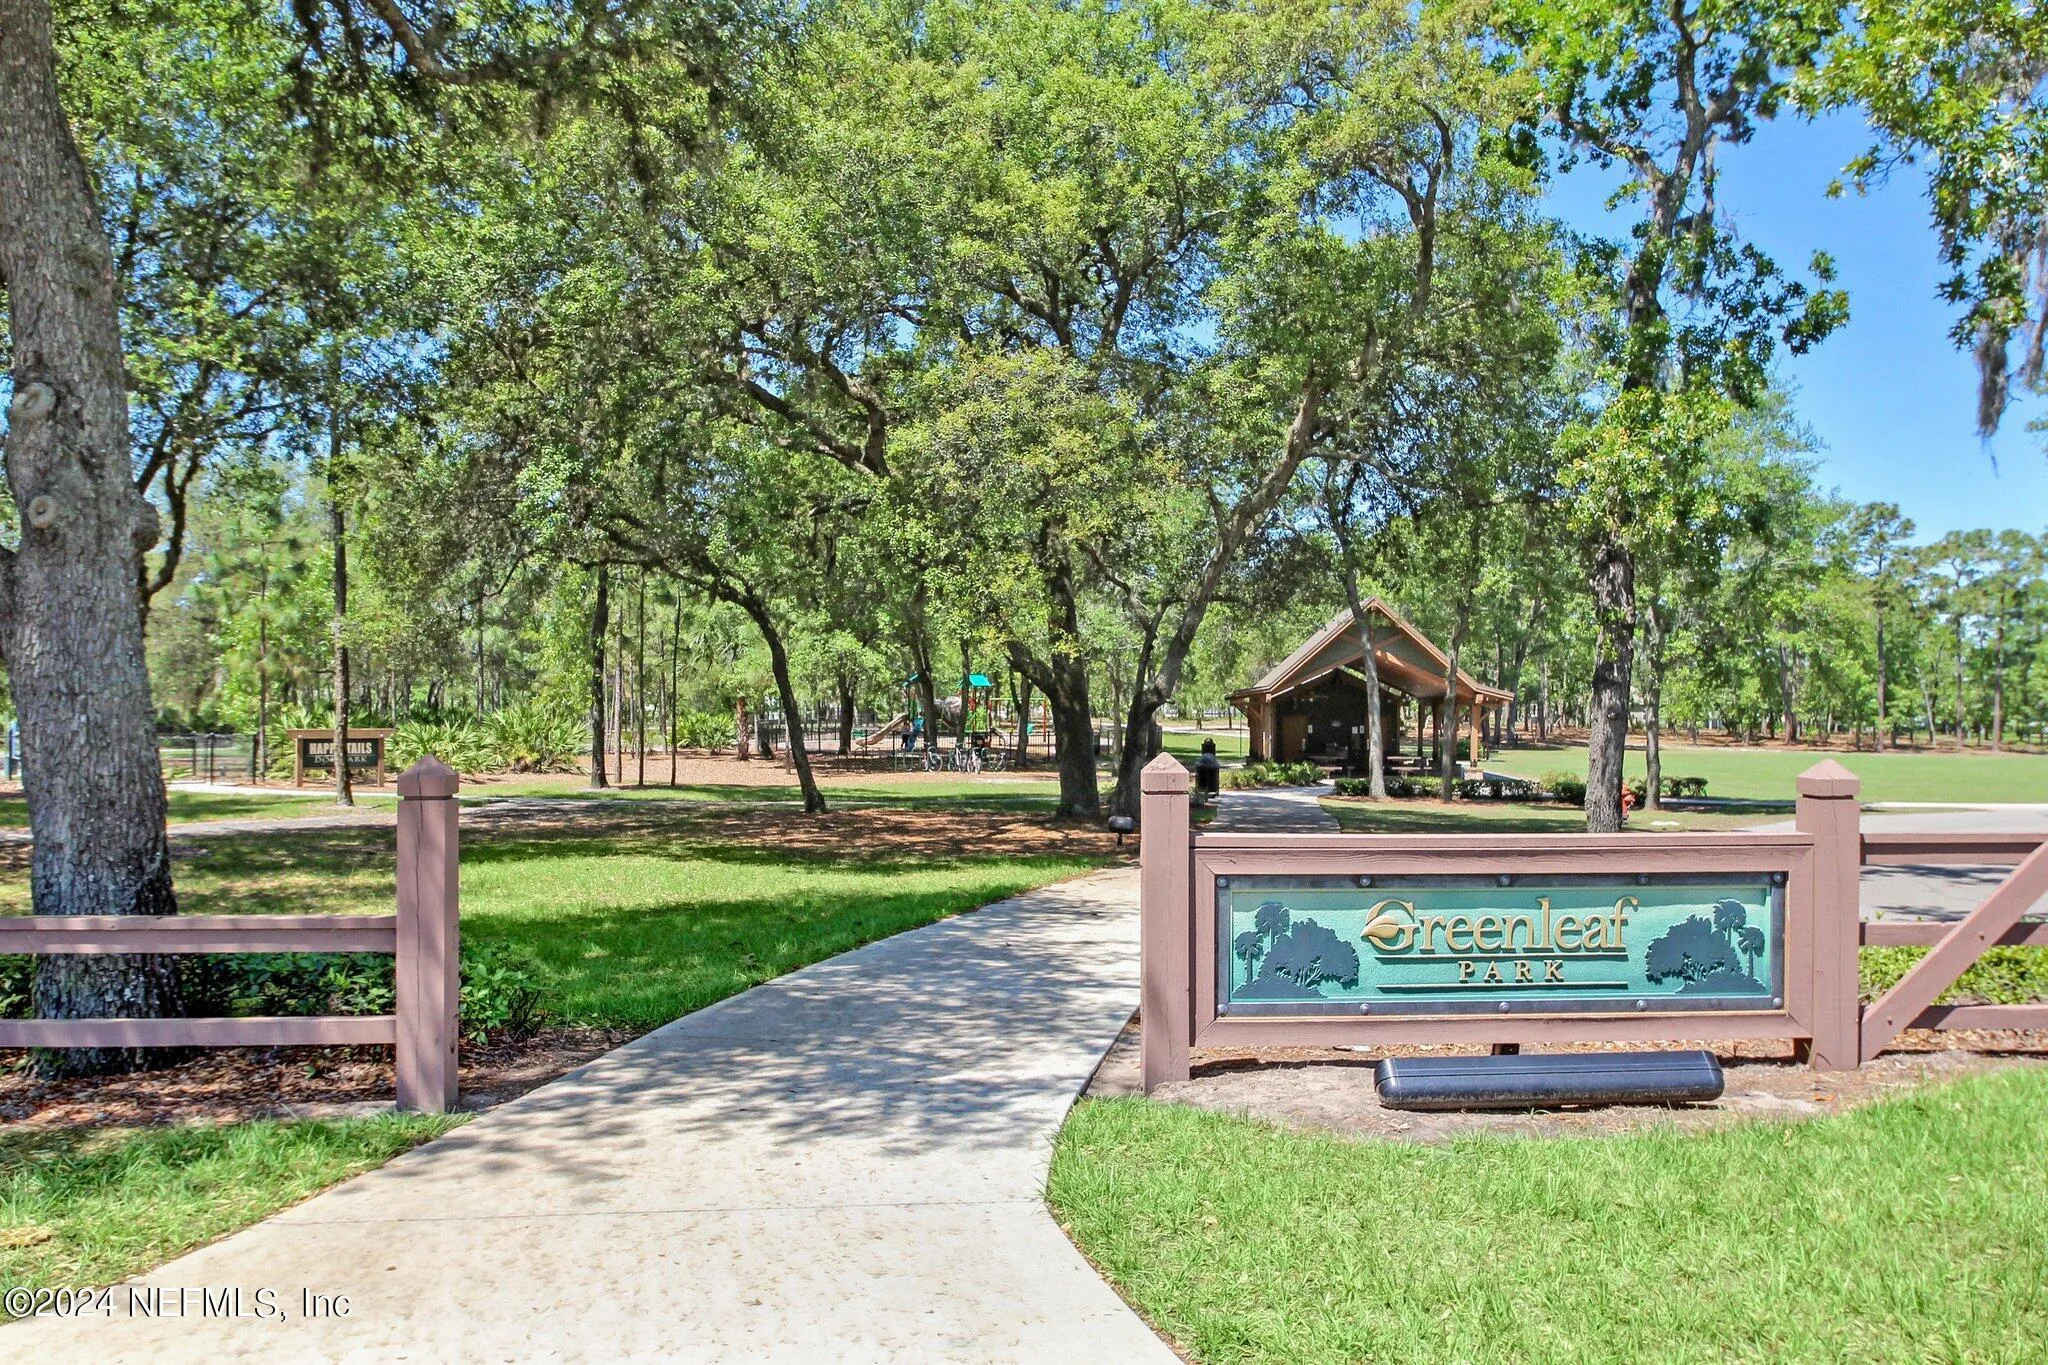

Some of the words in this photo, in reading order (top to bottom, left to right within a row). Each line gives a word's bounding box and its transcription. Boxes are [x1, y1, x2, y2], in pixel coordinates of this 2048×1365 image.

[309, 743, 337, 754] HAPP
[347, 742, 372, 754] TAILS
[1361, 896, 1639, 952] Greenleaf
[1458, 960, 1564, 983] PARK
